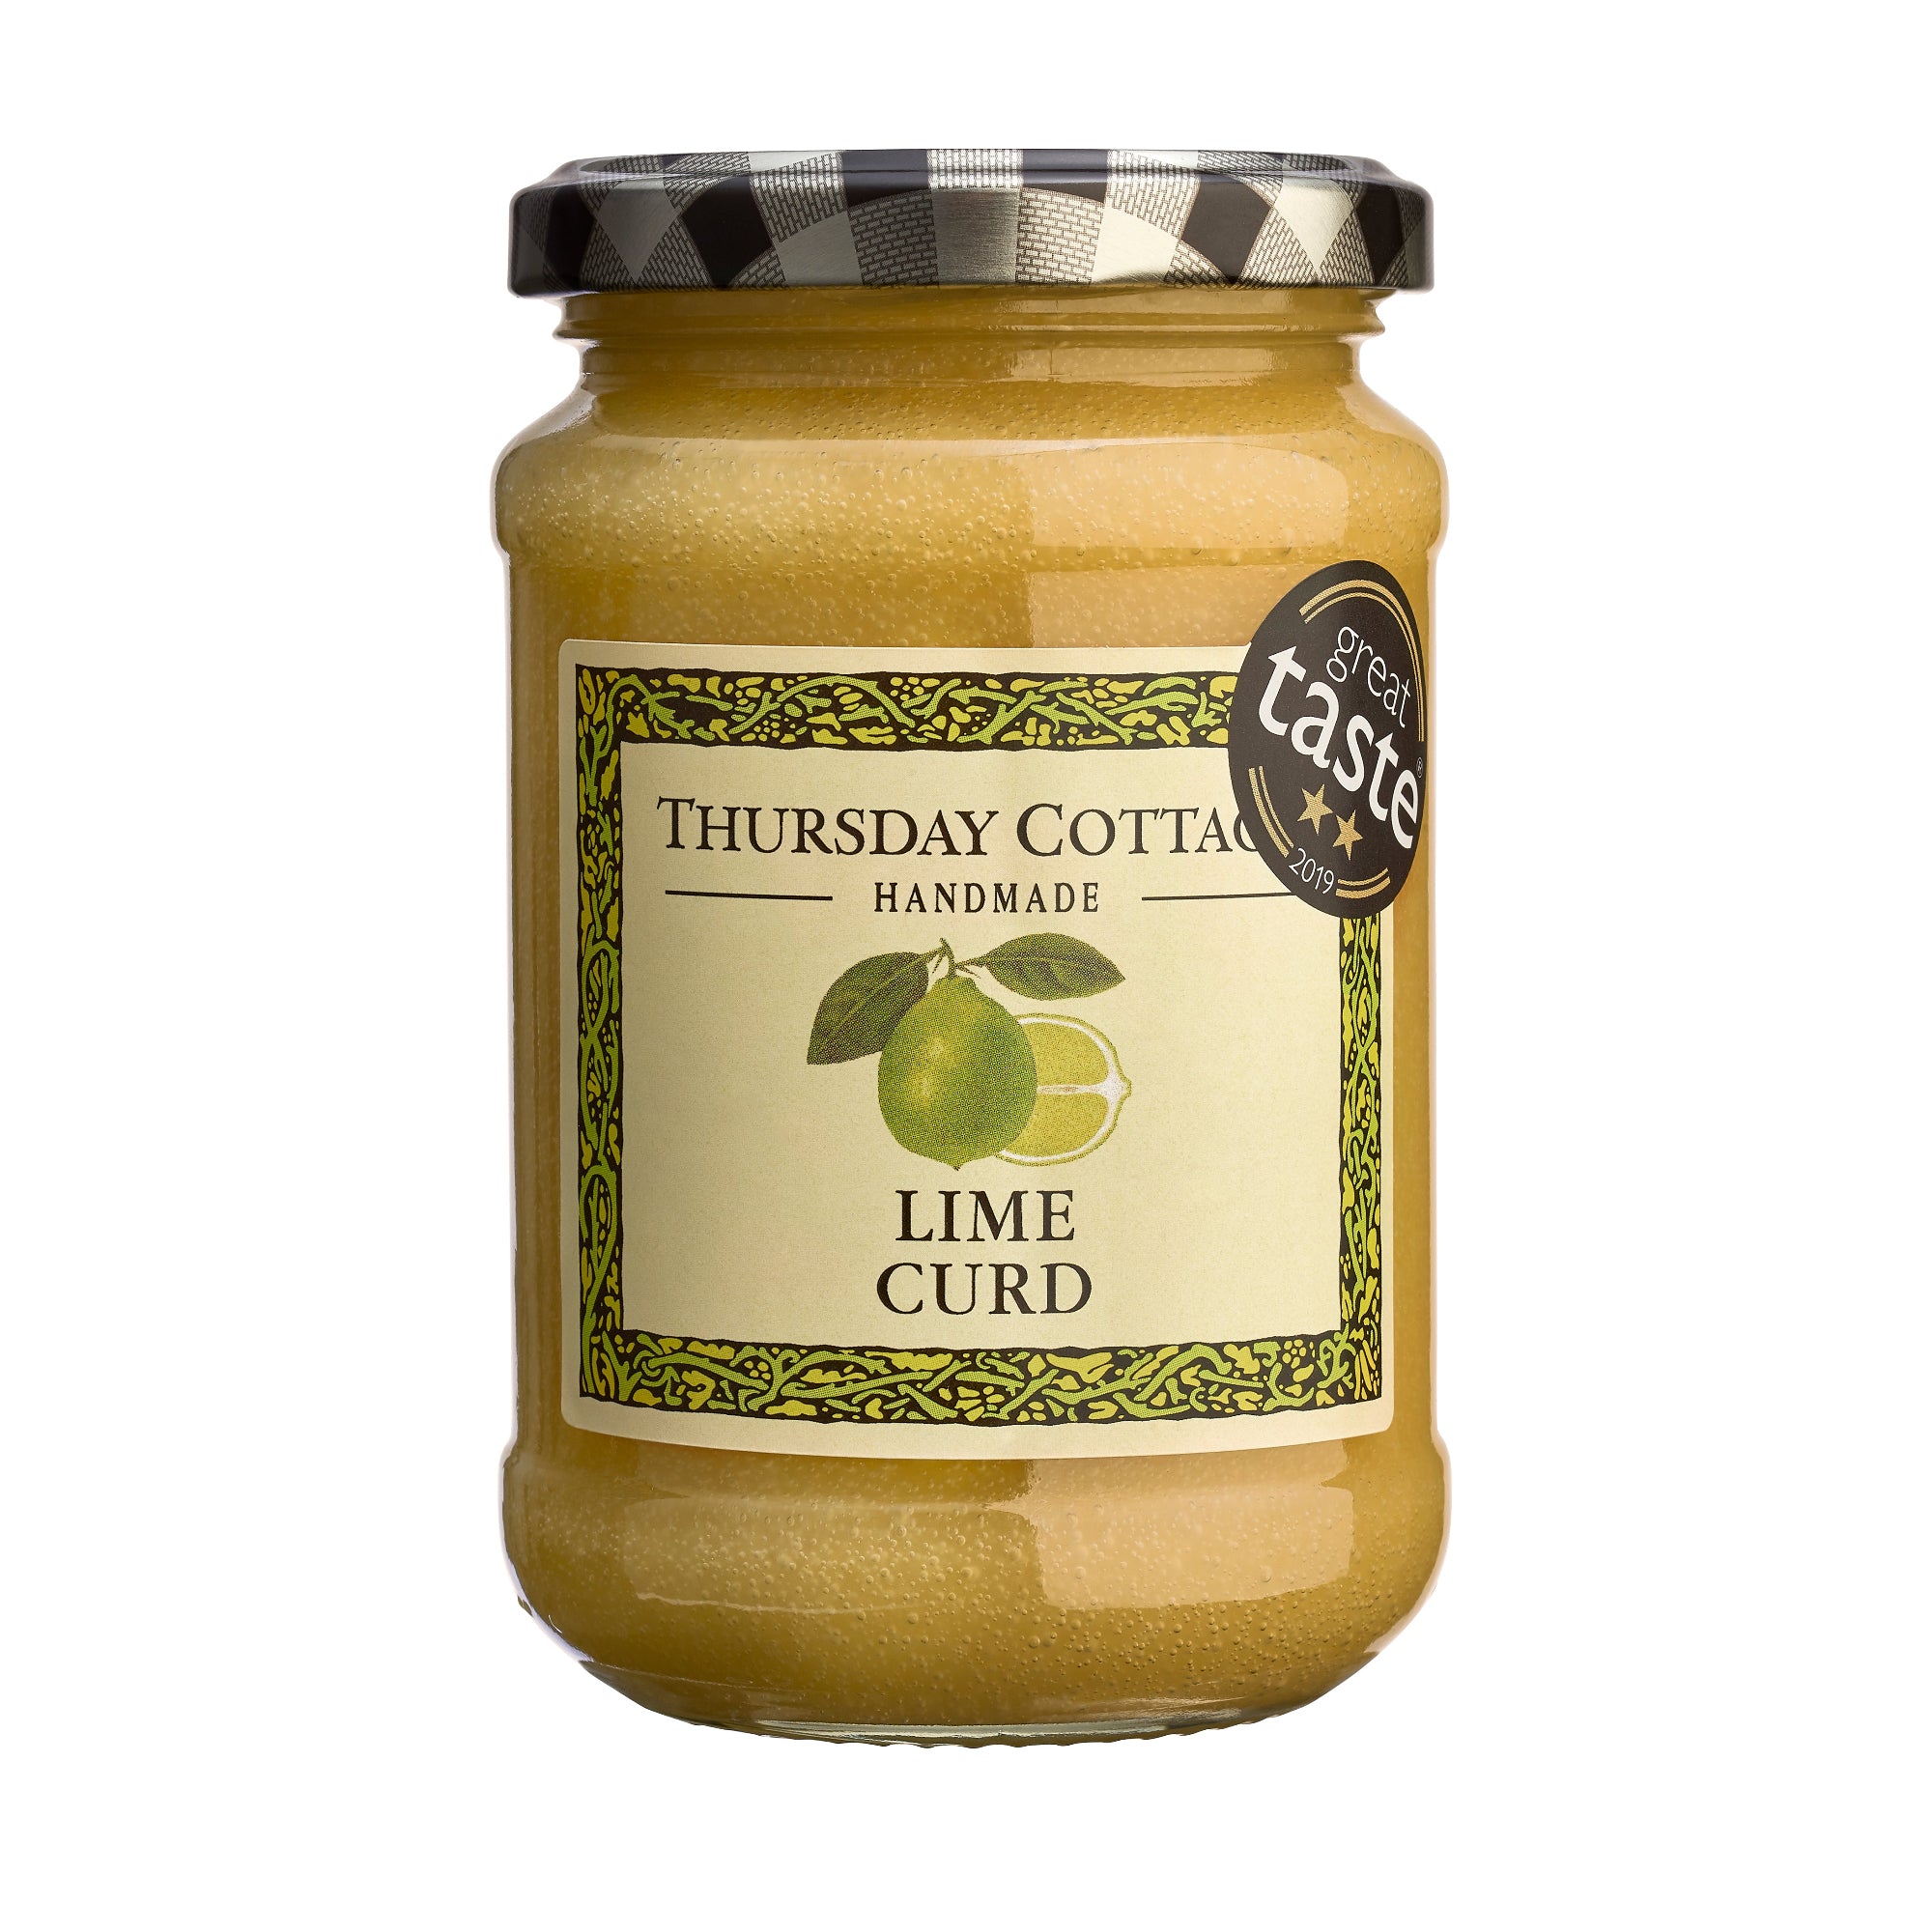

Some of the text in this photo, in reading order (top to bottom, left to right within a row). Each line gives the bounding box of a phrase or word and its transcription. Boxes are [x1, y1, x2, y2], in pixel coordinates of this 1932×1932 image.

[1326, 626, 1411, 728] great
[656, 796, 999, 858] THURSDAY
[1288, 847, 1335, 895] 2019
[873, 882, 1099, 914] HANDMADE
[895, 1189, 1075, 1242] LIME
[876, 1262, 1093, 1316] CURD
